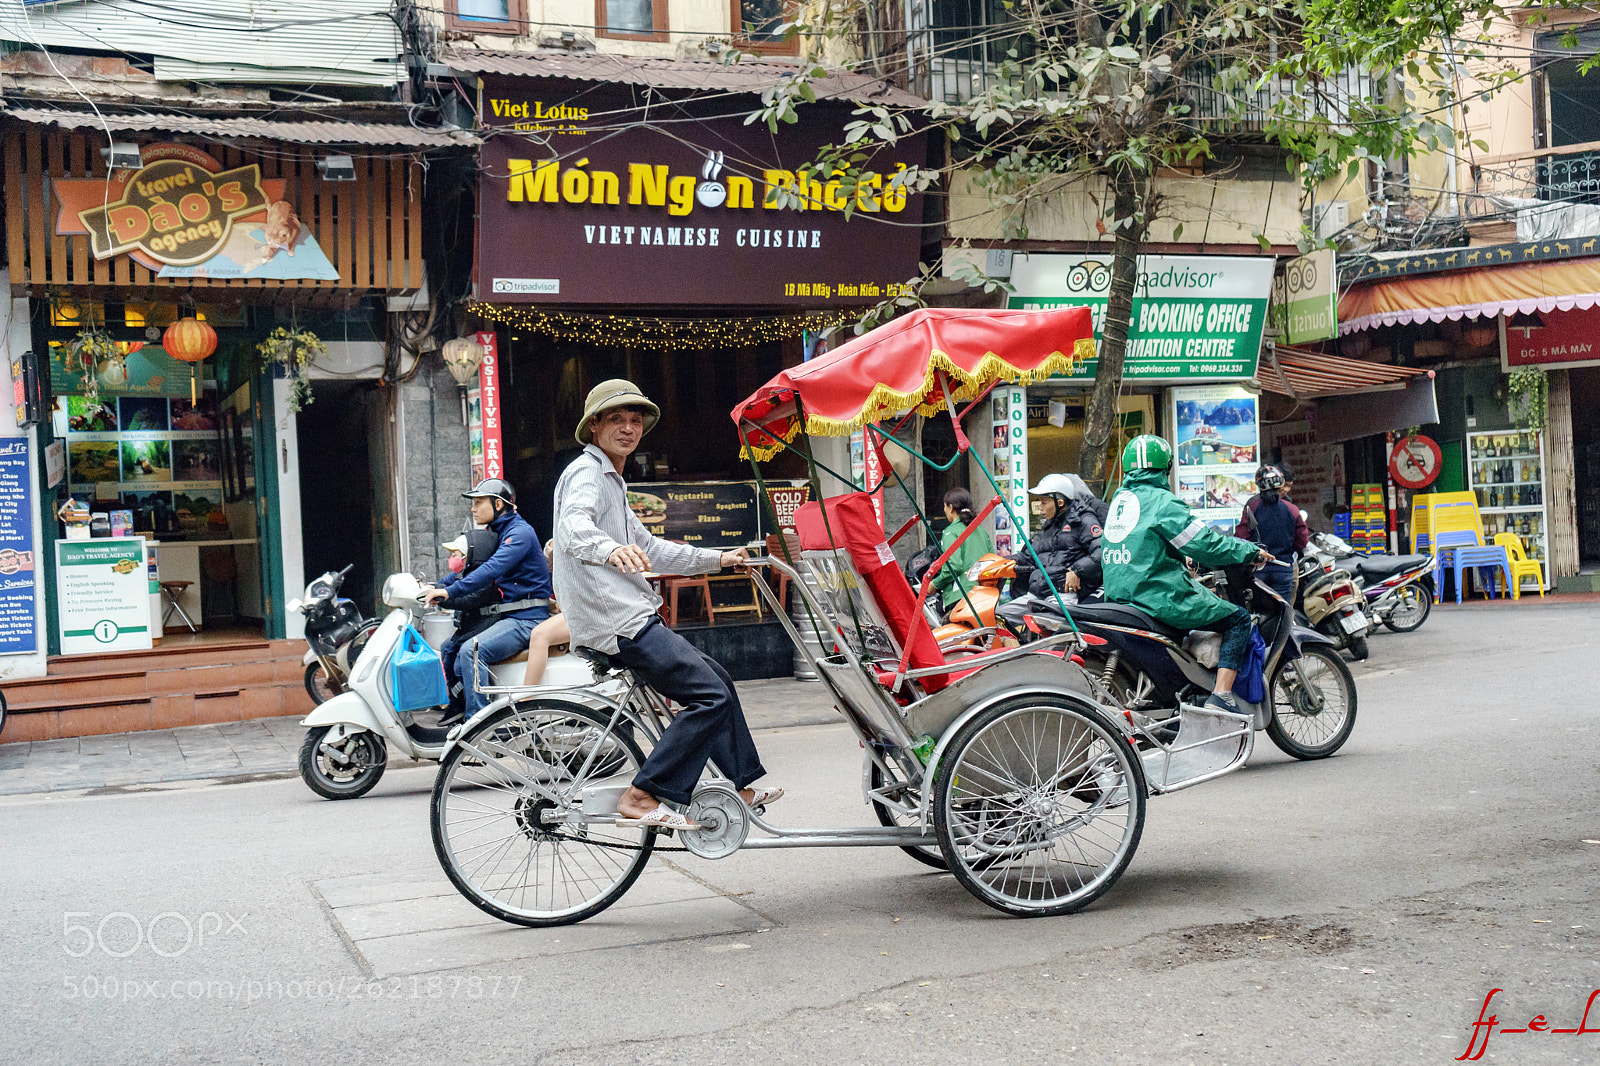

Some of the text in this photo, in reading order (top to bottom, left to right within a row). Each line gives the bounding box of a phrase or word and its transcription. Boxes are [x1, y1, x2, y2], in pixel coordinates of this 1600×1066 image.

[490, 99, 588, 120] Viet Lotus
[136, 167, 195, 197] travel
[507, 158, 620, 206] Món
[150, 219, 222, 252] agency
[584, 225, 822, 248] VIETNAMESE CUISINE
[514, 283, 556, 291] tripadvisor
[785, 283, 795, 296] 1B
[1136, 266, 1218, 292] padvisor
[1139, 303, 1204, 333] BOOKING
[1206, 304, 1252, 333] OFFICE
[1125, 338, 1236, 358] RMATION CENTRE
[1542, 348, 1548, 356] 5
[1129, 365, 1180, 375] tripadvisor.com
[1189, 364, 1199, 373] Tel:
[487, 438, 500, 479] TRAV
[867, 432, 879, 488] RAVEL
[1012, 392, 1024, 506] BOOKING
[668, 492, 714, 501] Vegetarian
[773, 492, 801, 504] COLD
[1103, 544, 1131, 565] Grab
